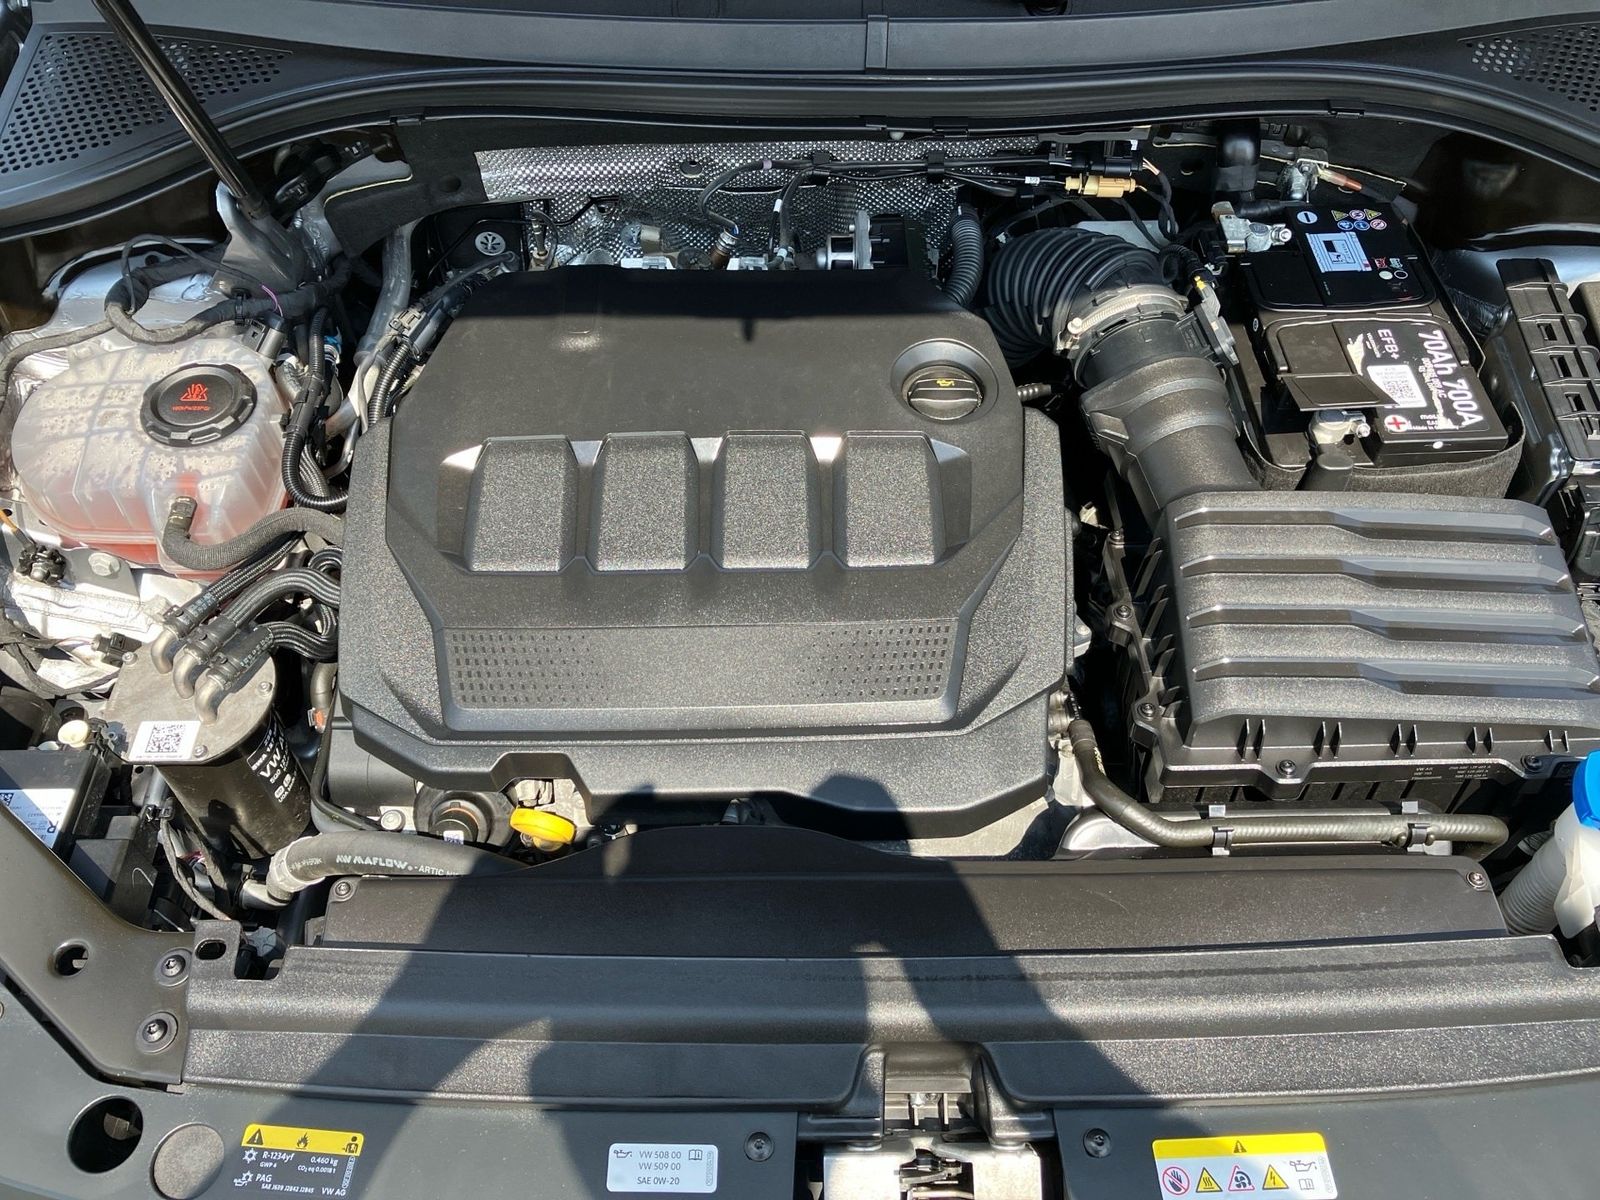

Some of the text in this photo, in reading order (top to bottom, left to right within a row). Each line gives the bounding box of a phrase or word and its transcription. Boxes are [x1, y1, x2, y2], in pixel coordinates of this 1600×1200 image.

[1378, 329, 1400, 360] EFB+
[1418, 329, 1458, 375] 70Ah
[1442, 379, 1484, 426] 700A
[260, 747, 281, 778] VW
[353, 855, 408, 870] MAFLOW
[262, 1150, 295, 1161] R-1234yf
[654, 1151, 669, 1159] 508
[670, 1151, 681, 1159] 00
[310, 1156, 339, 1166] 0.460 kg
[638, 1162, 652, 1170] VW
[654, 1163, 669, 1171] 509
[255, 1173, 272, 1183] PAG
[637, 1177, 680, 1185] SAE 0W-20
[321, 1187, 346, 1197] VW AG
